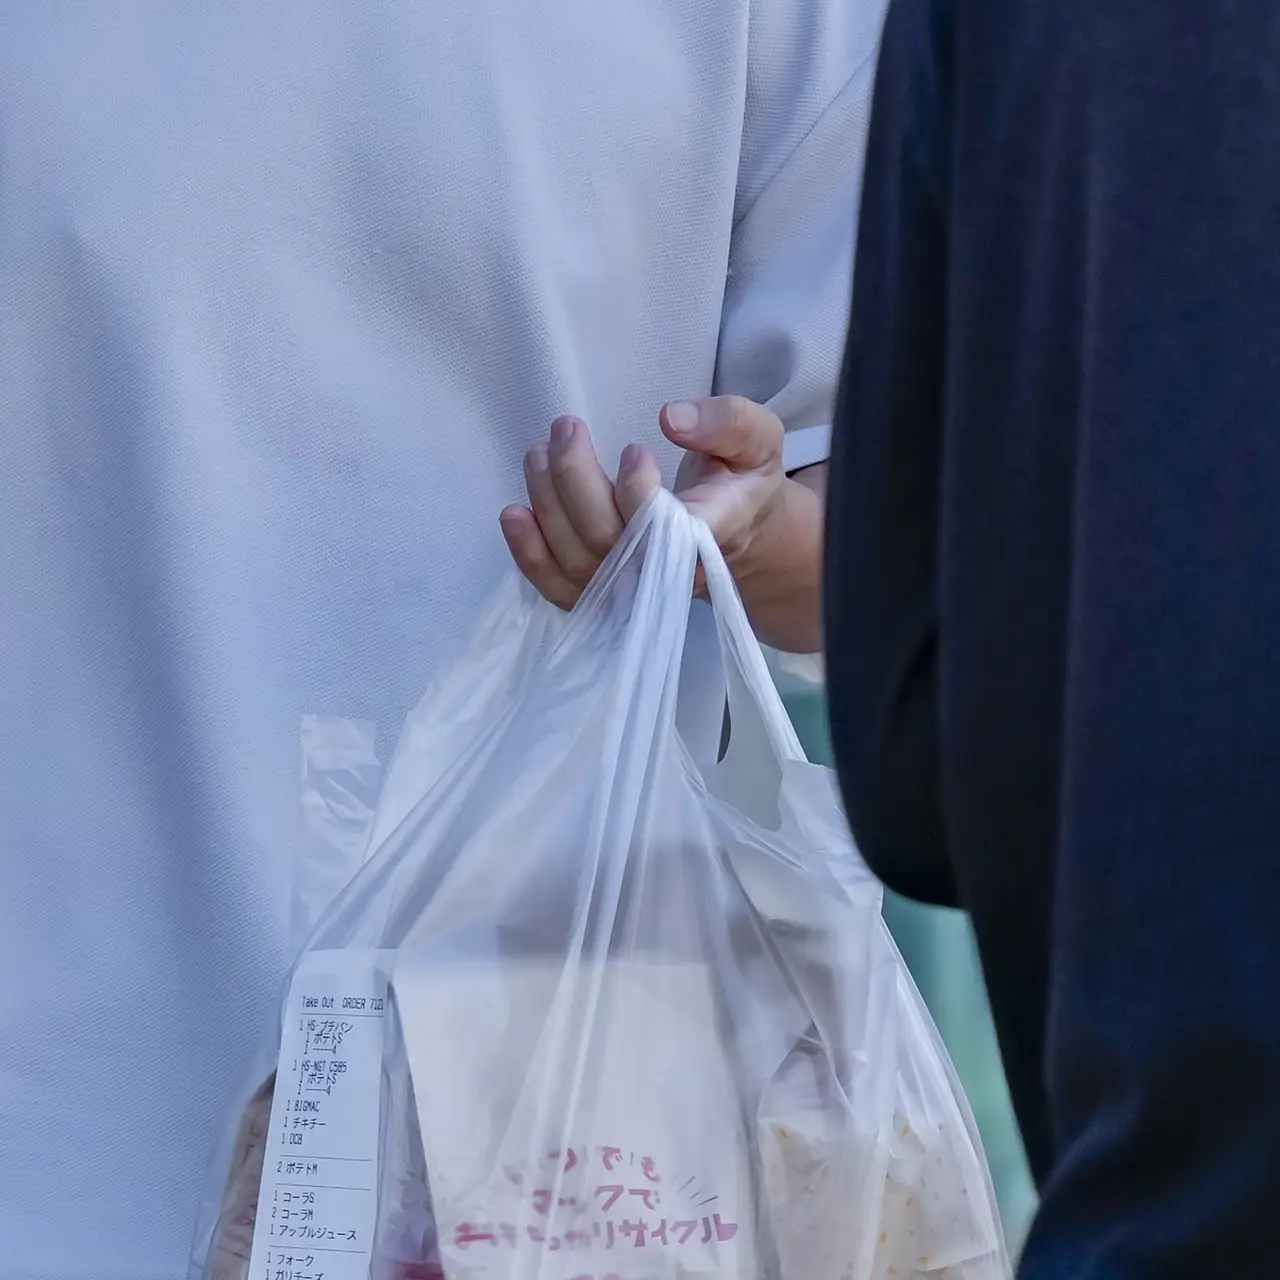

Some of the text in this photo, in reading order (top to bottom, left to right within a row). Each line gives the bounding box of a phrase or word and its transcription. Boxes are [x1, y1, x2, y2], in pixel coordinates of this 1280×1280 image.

[302, 996, 318, 1008] Take
[322, 997, 334, 1008] Out
[342, 997, 366, 1010] ORDER
[294, 1100, 321, 1112] BIGMAC
[292, 1117, 327, 1131] チキチー
[277, 1161, 318, 1176] 2 ポテトM
[283, 1192, 315, 1204] コーラS
[271, 1207, 314, 1221] 2 コーラM
[278, 1225, 357, 1241] アップルジュース
[277, 1253, 315, 1266] フォーク
